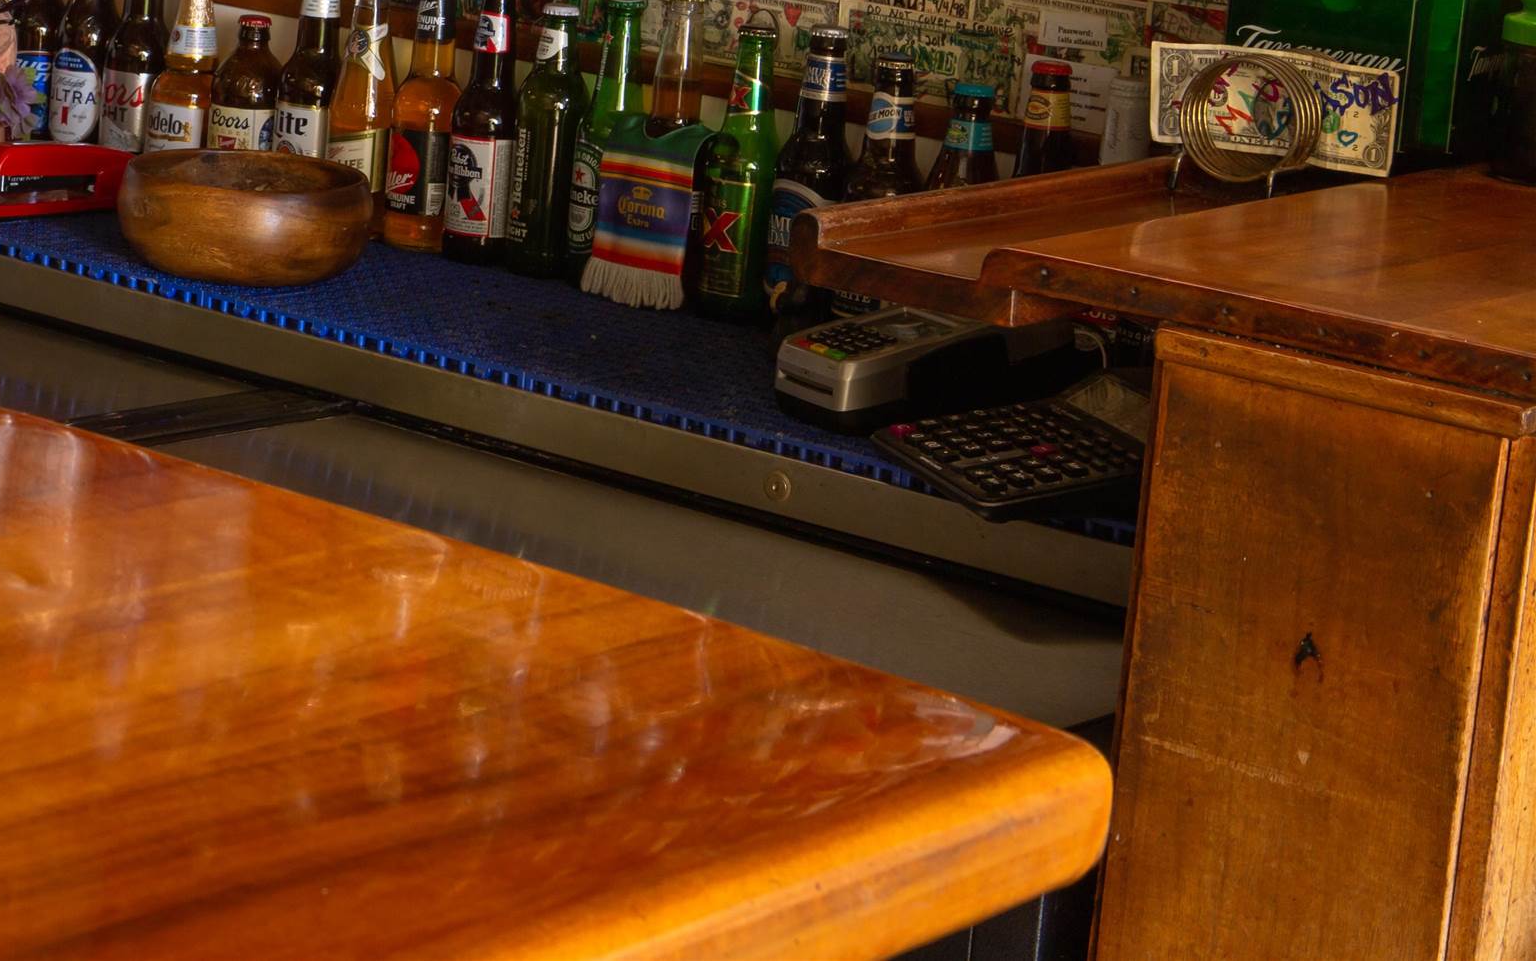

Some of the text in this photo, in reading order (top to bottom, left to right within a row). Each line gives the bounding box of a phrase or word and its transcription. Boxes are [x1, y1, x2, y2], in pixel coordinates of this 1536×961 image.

[1052, 0, 1081, 10] STATES
[104, 82, 145, 108] ors
[211, 107, 250, 130] Coors
[617, 195, 666, 219] Corona
